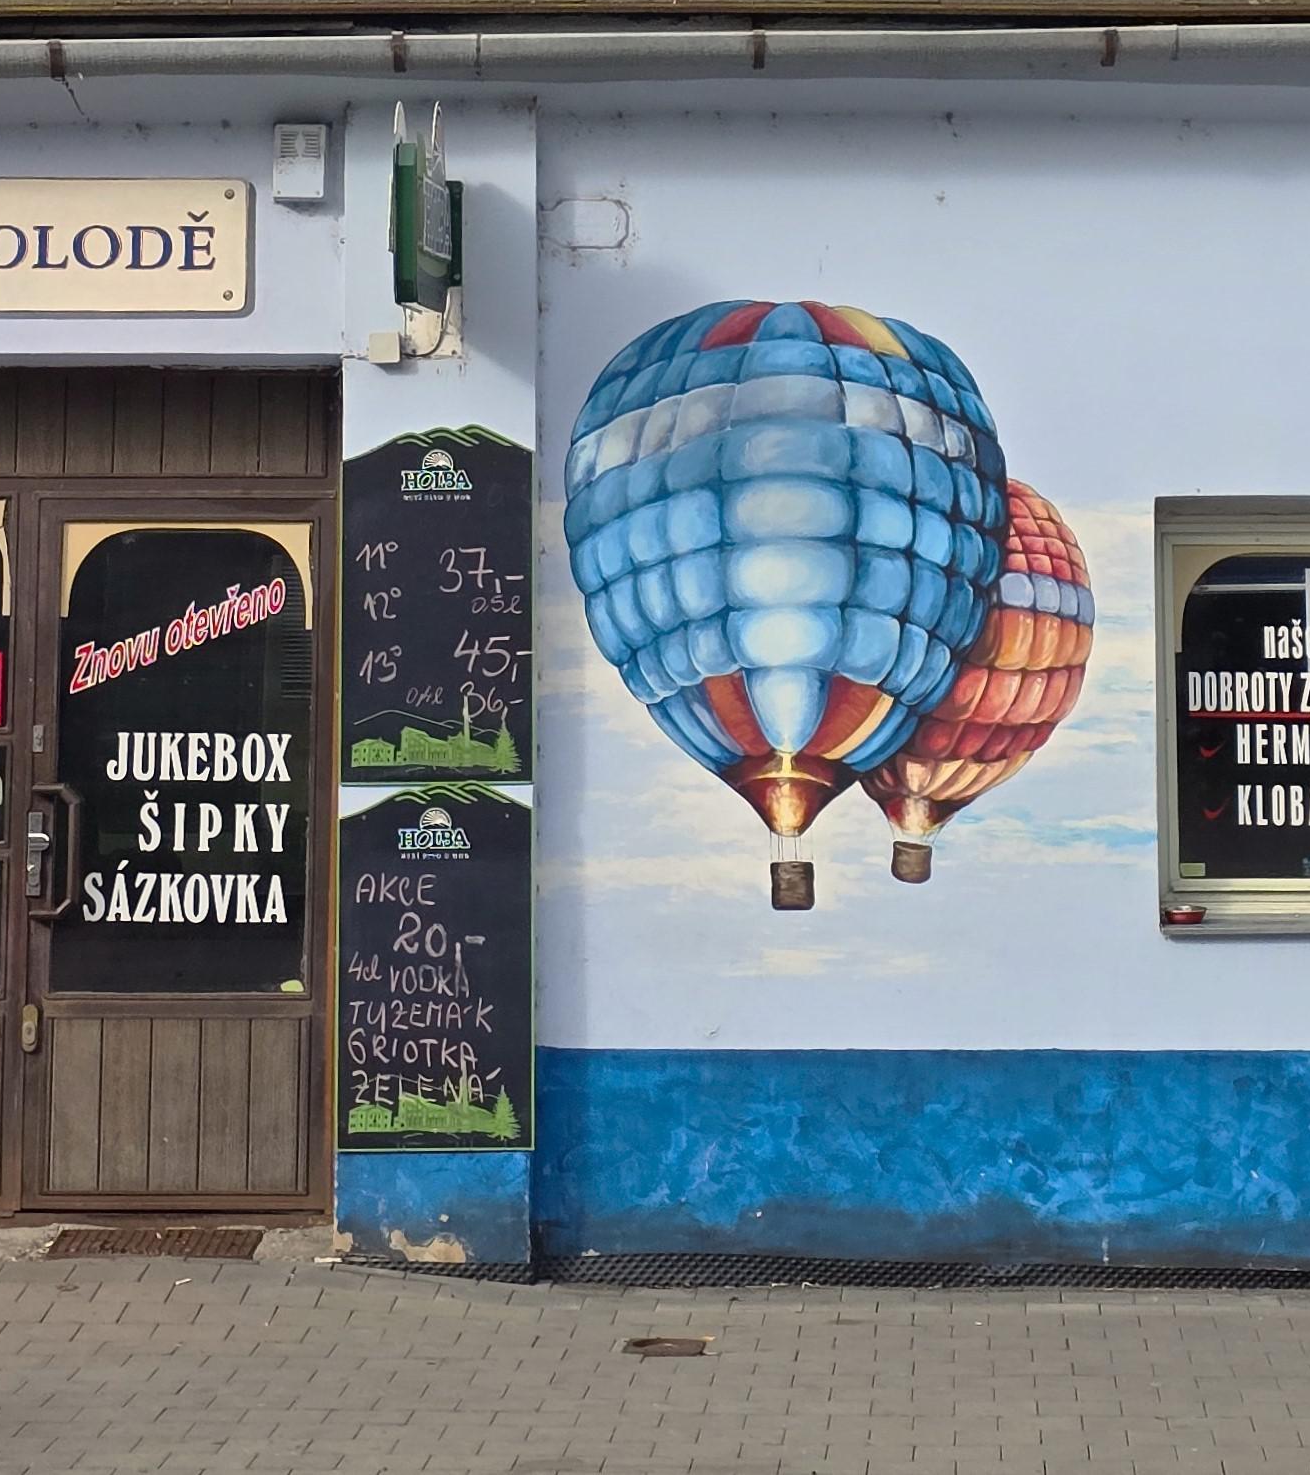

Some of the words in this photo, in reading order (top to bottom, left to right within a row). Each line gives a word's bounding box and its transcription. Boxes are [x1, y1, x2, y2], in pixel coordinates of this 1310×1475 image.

[401, 470, 473, 491] HOLBA
[69, 626, 161, 695] Znovu
[164, 577, 287, 657] otevřeno
[1188, 672, 1293, 713] DOBROTY
[106, 731, 291, 782] JUKEBOX
[138, 789, 291, 853] ŠIPKY
[398, 828, 471, 850] HOLBA
[83, 860, 288, 924] SÁZKOVKA
[355, 873, 437, 906] AKCE
[390, 964, 469, 998] VODKA
[348, 1028, 477, 1070] GRIOTKA
